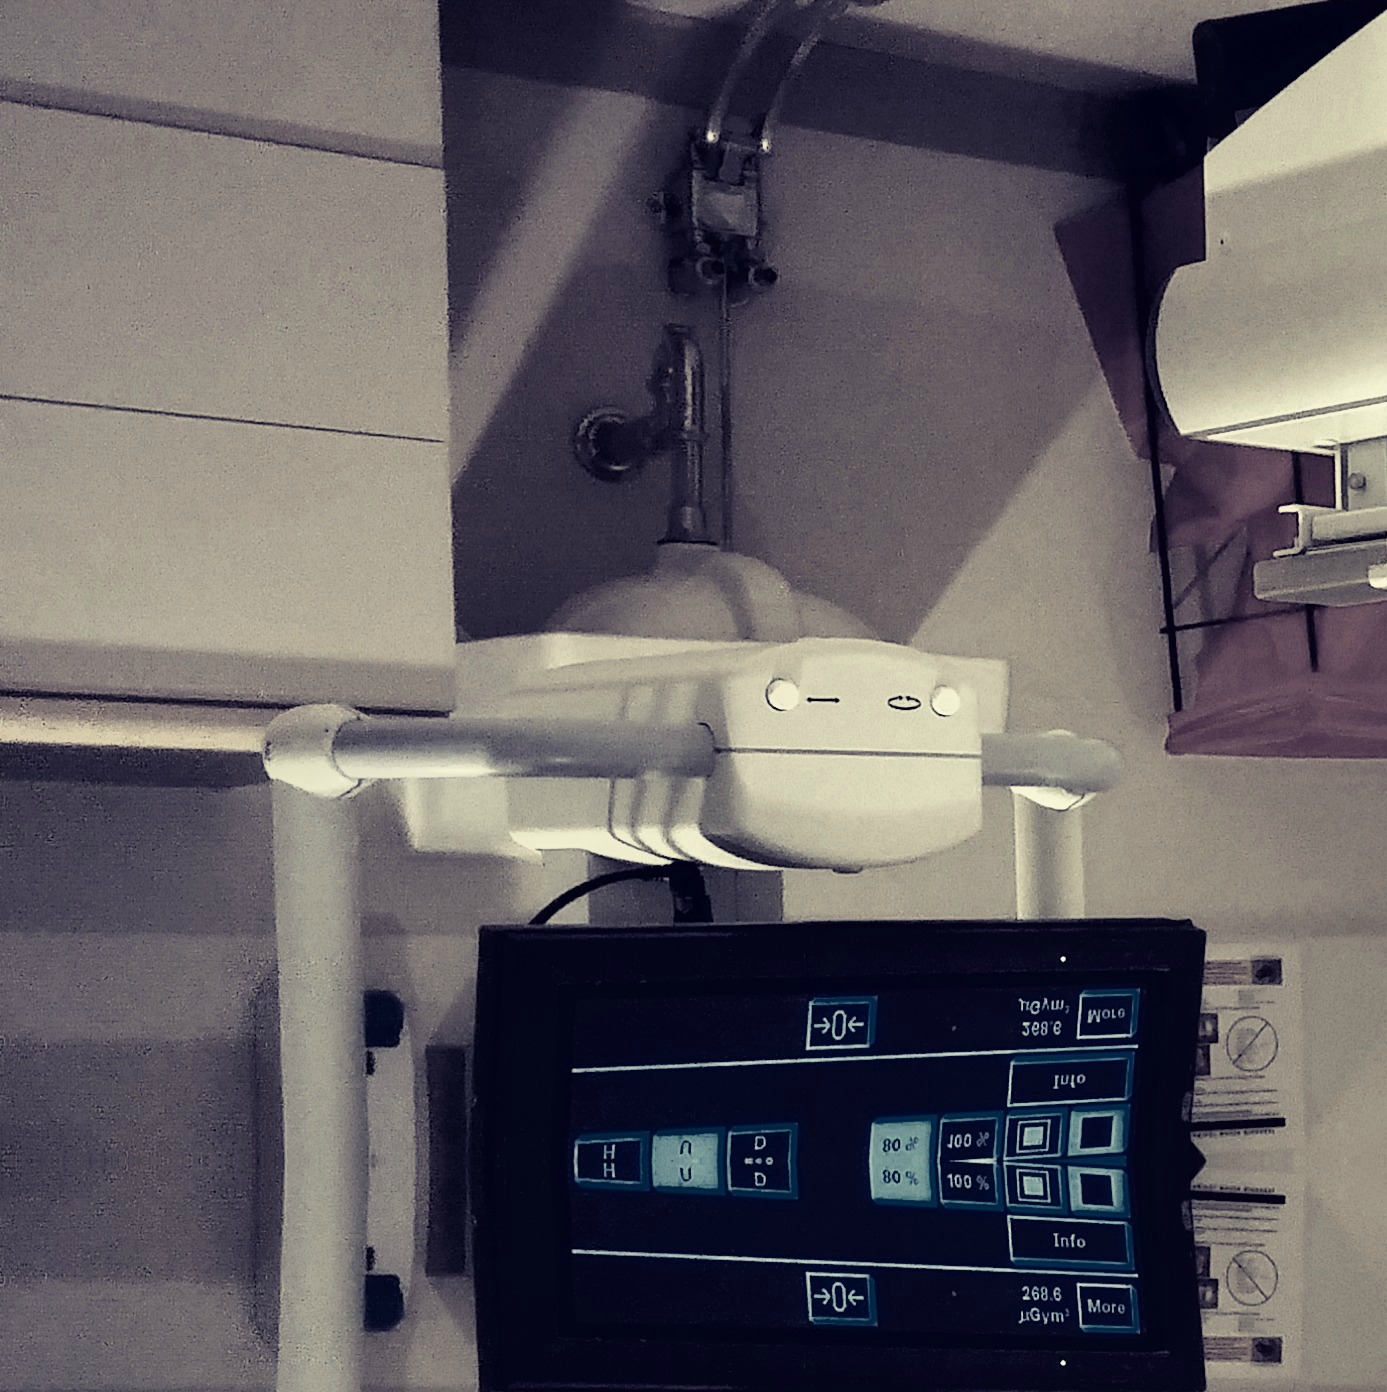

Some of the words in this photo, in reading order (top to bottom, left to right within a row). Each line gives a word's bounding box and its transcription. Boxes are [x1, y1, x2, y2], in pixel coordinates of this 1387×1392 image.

[882, 1169, 901, 1184] 80
[905, 1171, 919, 1186] %
[946, 1173, 972, 1190] 100
[976, 1175, 990, 1190] %
[1053, 1232, 1086, 1248] Info
[1022, 1286, 1062, 1301] 268.6
[1087, 1298, 1126, 1314] More
